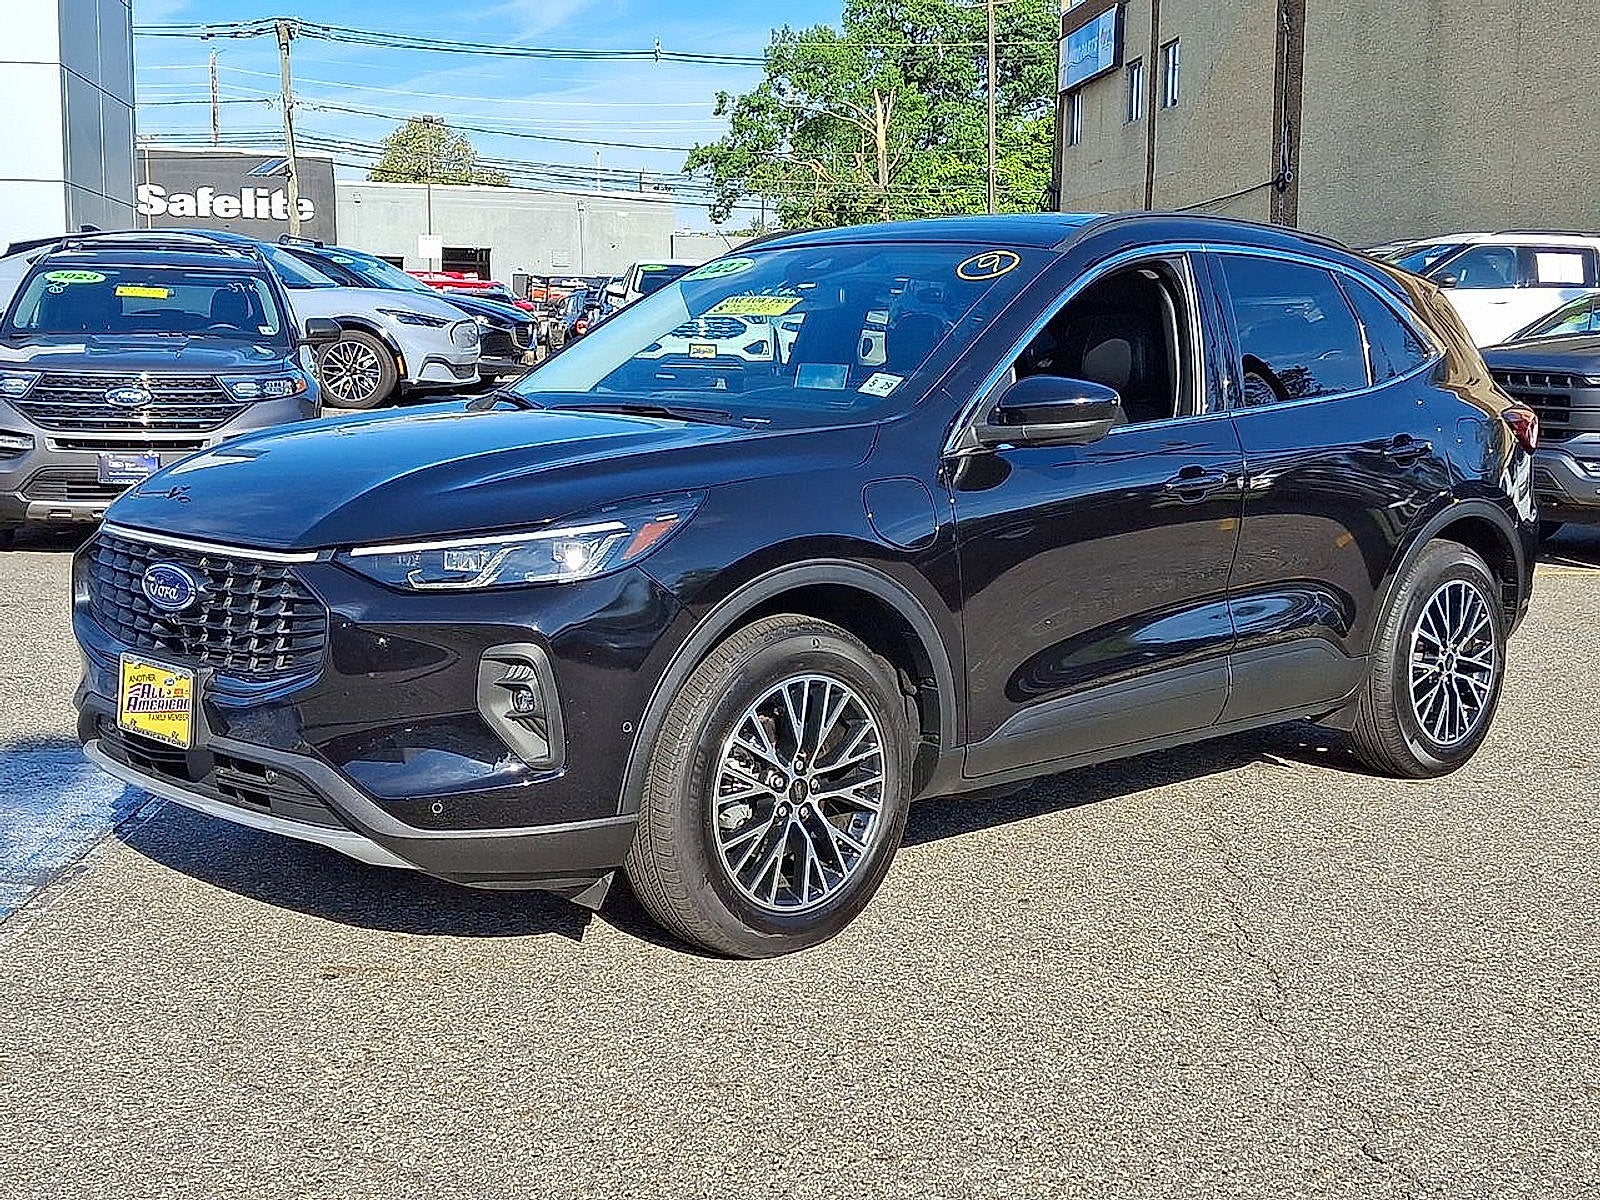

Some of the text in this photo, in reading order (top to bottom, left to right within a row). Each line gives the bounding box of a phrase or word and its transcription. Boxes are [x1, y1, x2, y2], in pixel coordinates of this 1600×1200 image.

[137, 183, 315, 221] Safelite
[147, 572, 180, 600] Ford
[129, 674, 157, 682] ANOTHER
[148, 713, 189, 721] FAMILY MEMBER
